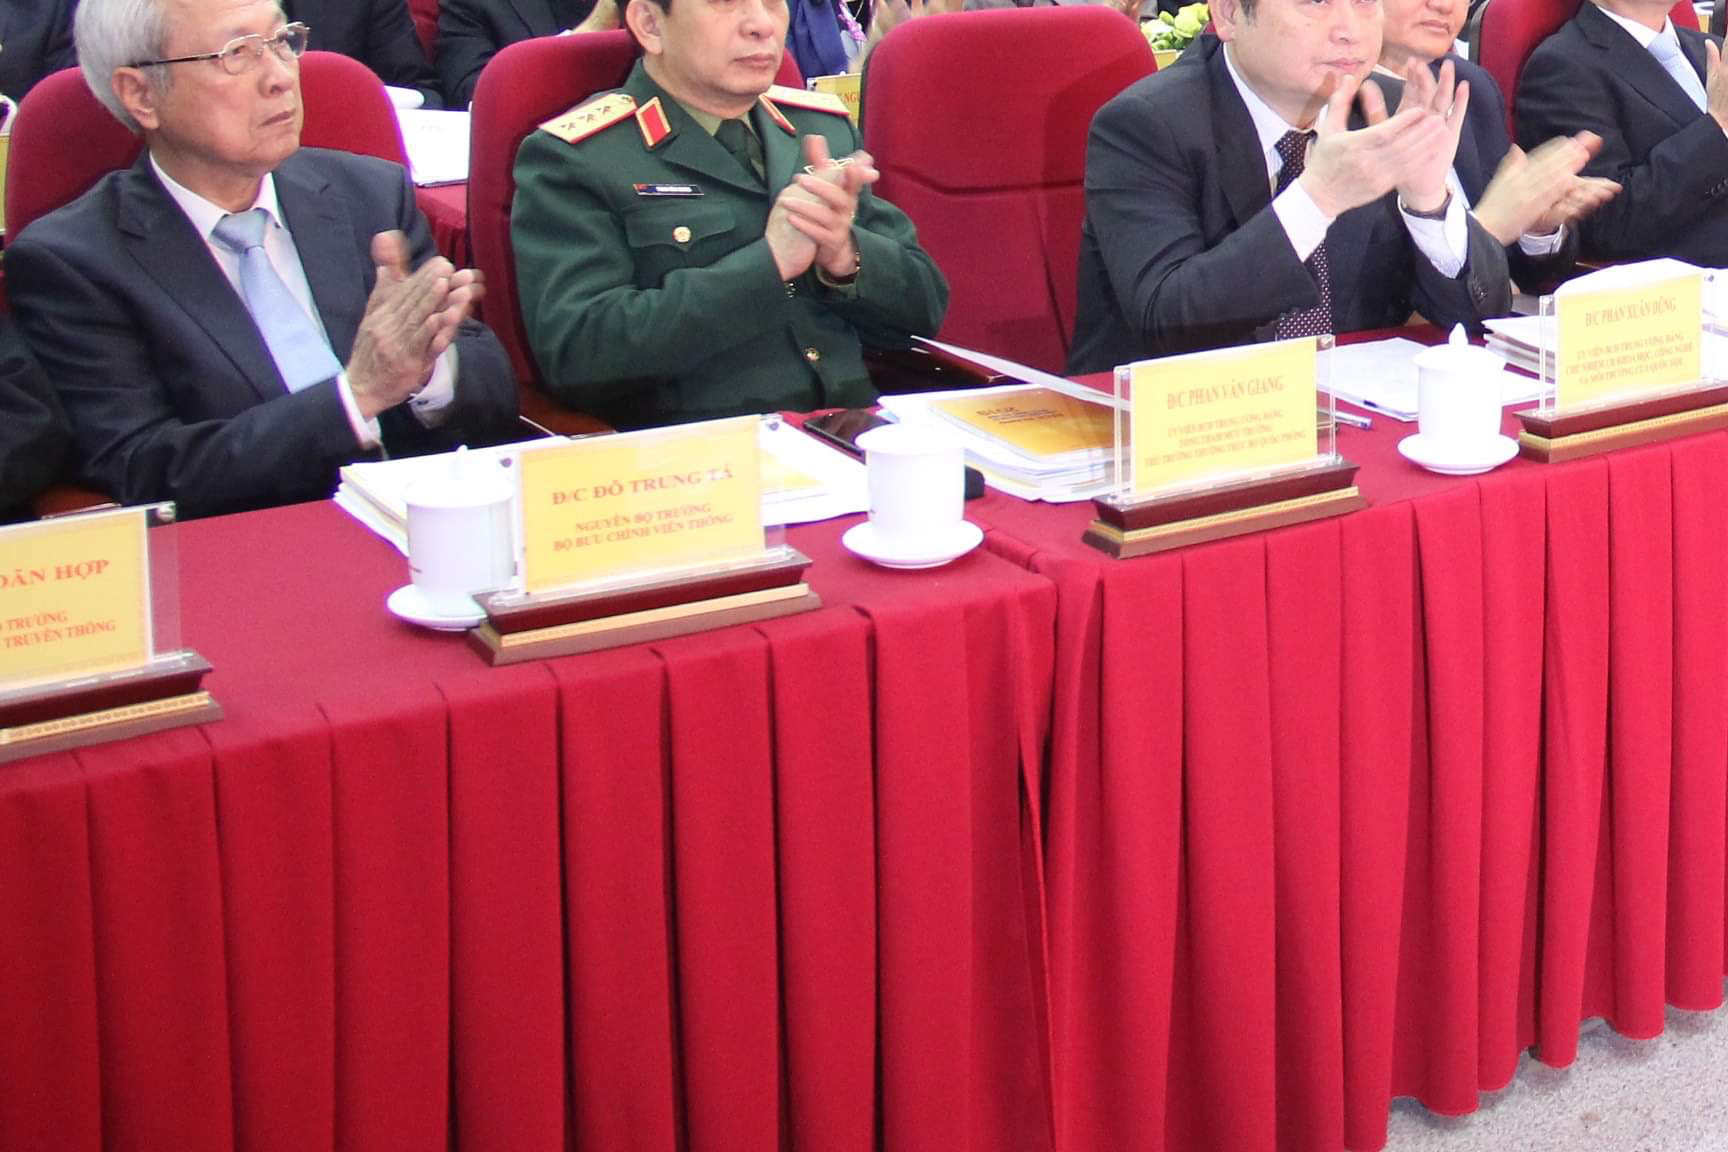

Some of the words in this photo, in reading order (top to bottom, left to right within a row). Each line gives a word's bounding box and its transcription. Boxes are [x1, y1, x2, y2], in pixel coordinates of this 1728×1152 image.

[1189, 386, 1219, 406] PHAN
[1248, 376, 1285, 395] GIANG
[552, 488, 586, 505] Đ/C
[629, 471, 702, 494] TRUNG
[54, 559, 110, 580] HỢP
